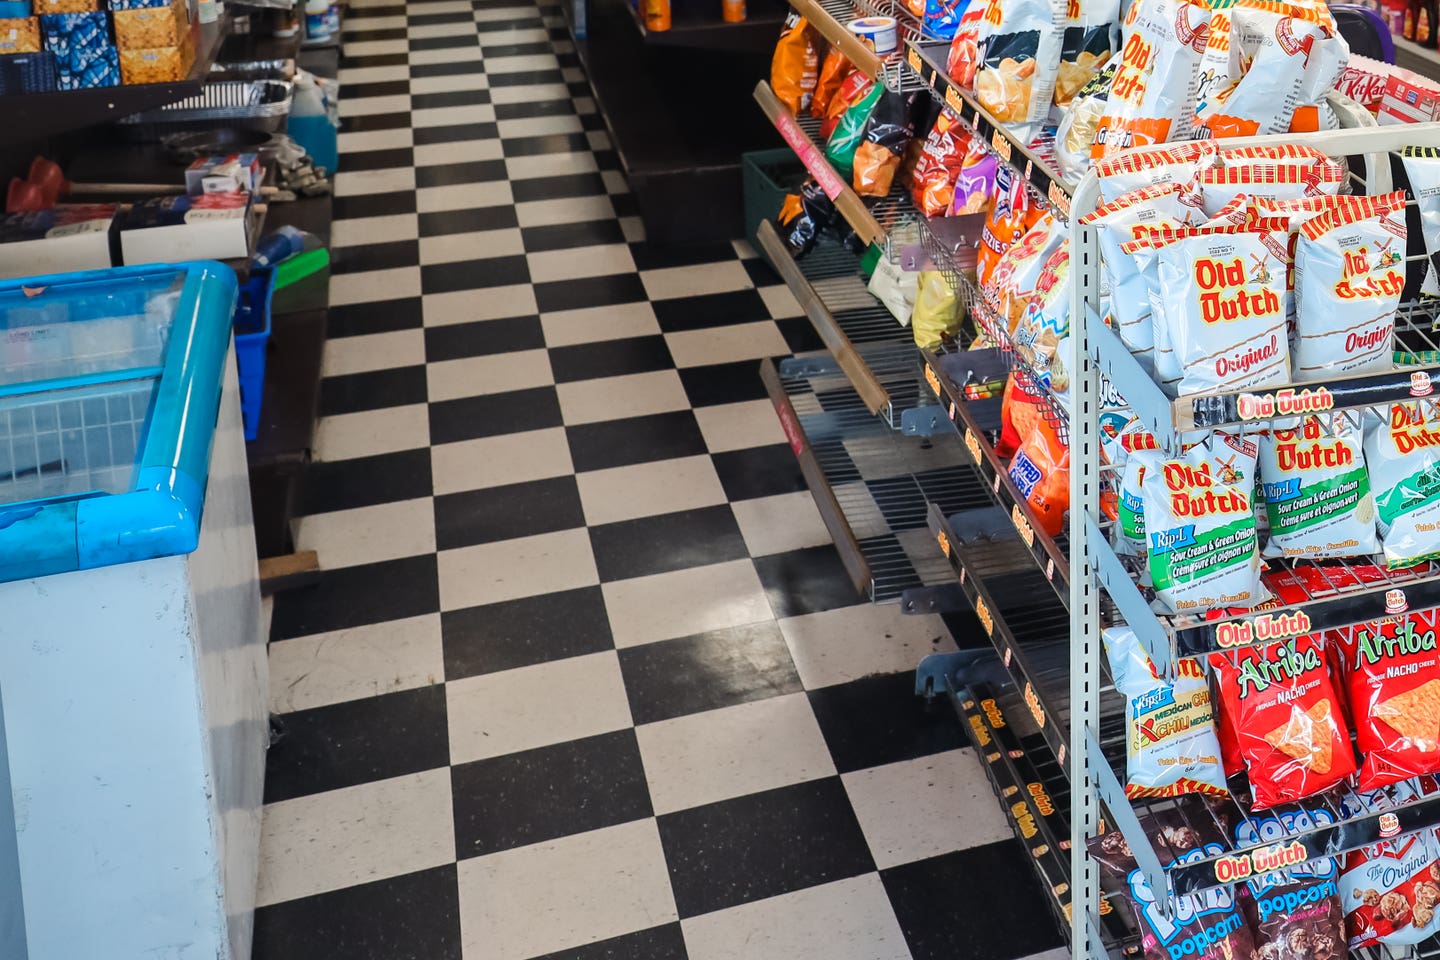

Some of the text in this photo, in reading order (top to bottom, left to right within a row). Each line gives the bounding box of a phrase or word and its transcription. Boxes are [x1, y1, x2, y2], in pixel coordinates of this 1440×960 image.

[1123, 33, 1151, 70] Old
[1345, 76, 1385, 104] KitKat
[1195, 258, 1246, 290] Old
[1201, 287, 1279, 324] Dutch
[1215, 336, 1279, 377] Original
[1239, 387, 1333, 418] Old Dutch
[1391, 403, 1424, 430] Old
[1277, 442, 1352, 471] Dutch
[1163, 464, 1210, 489] Old
[1170, 490, 1248, 518] Dutch
[1278, 481, 1358, 514] Sour Cream Green Onion
[1281, 493, 1358, 528] Crème sure oignon vert
[1170, 535, 1235, 564] Sour Cream Green
[1218, 549, 1241, 564] oignon
[1217, 613, 1310, 646] Old Dutch
[1355, 621, 1437, 670] Arriba
[1237, 639, 1321, 699] Arriba
[1387, 659, 1436, 679] NACHO CHEESE
[1277, 684, 1306, 705] NACHO
[1156, 716, 1189, 737] CHILI
[1217, 843, 1306, 882] Old Dutch
[1367, 848, 1429, 888] The Original
[1261, 881, 1337, 921] popcorn
[1169, 914, 1242, 960] popcorn
